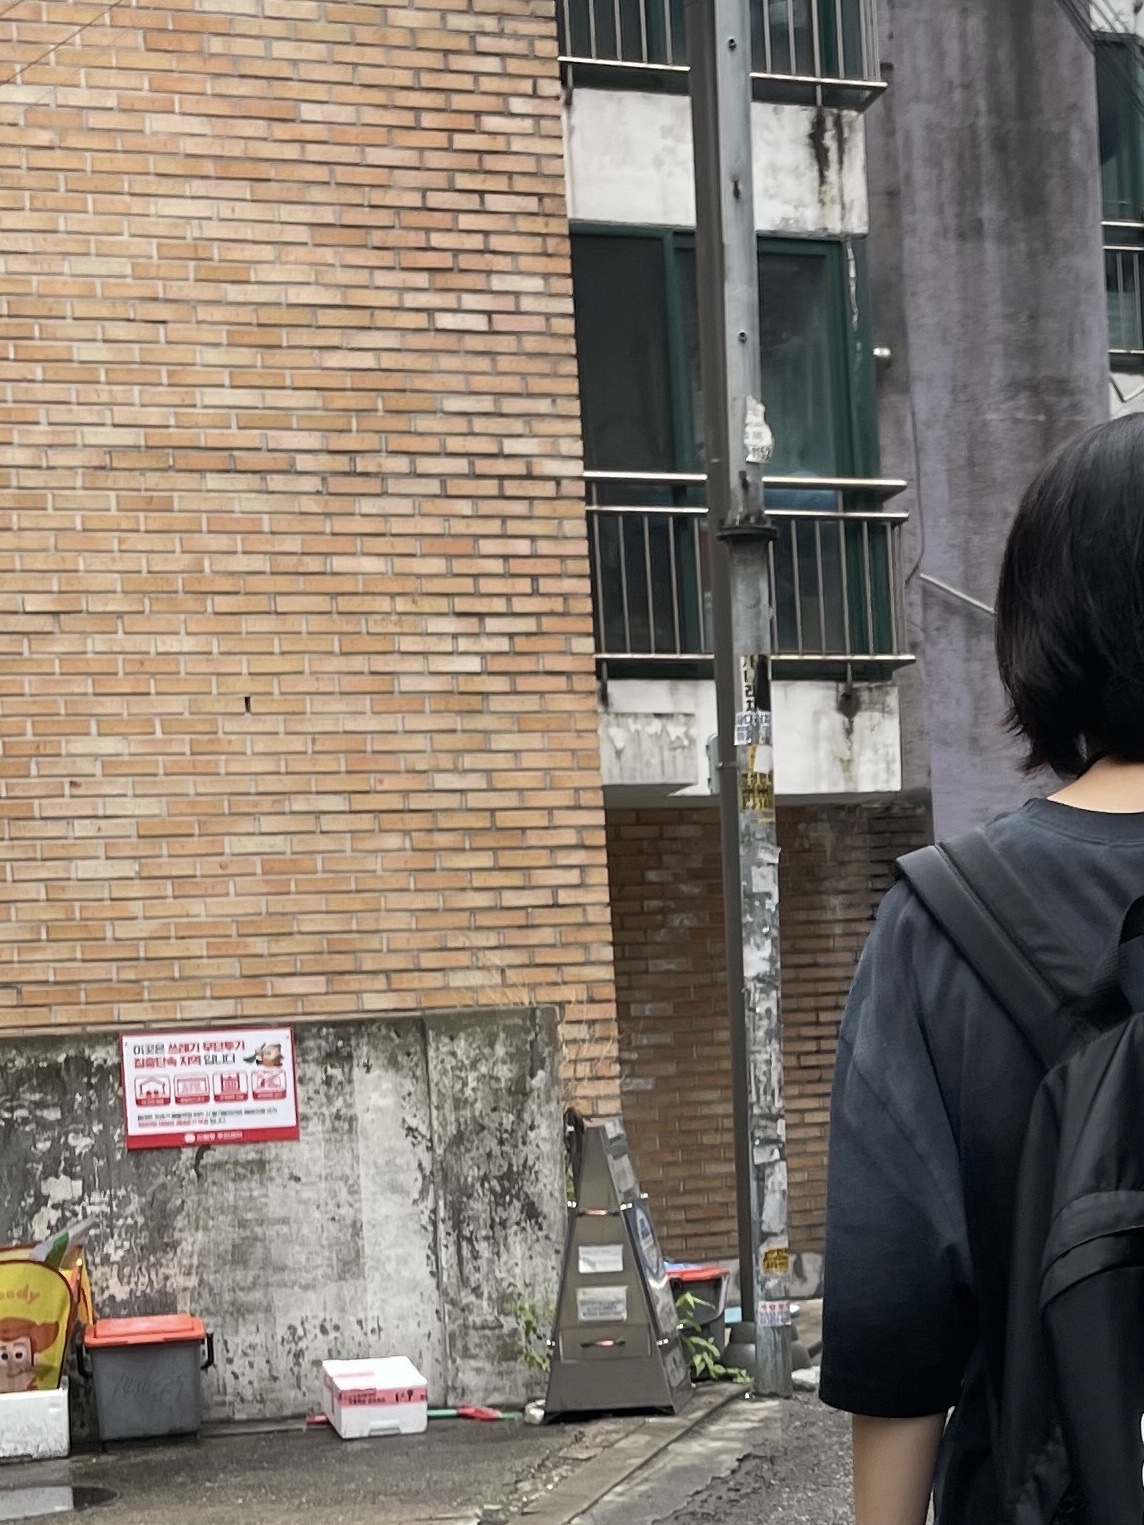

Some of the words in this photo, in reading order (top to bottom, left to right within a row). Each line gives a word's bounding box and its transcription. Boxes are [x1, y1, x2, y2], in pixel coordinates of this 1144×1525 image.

[168, 1041, 200, 1055] 쓰레기
[203, 1040, 245, 1053] 무단투기
[180, 1055, 202, 1067] 지역
[204, 1053, 236, 1065] 입니다
